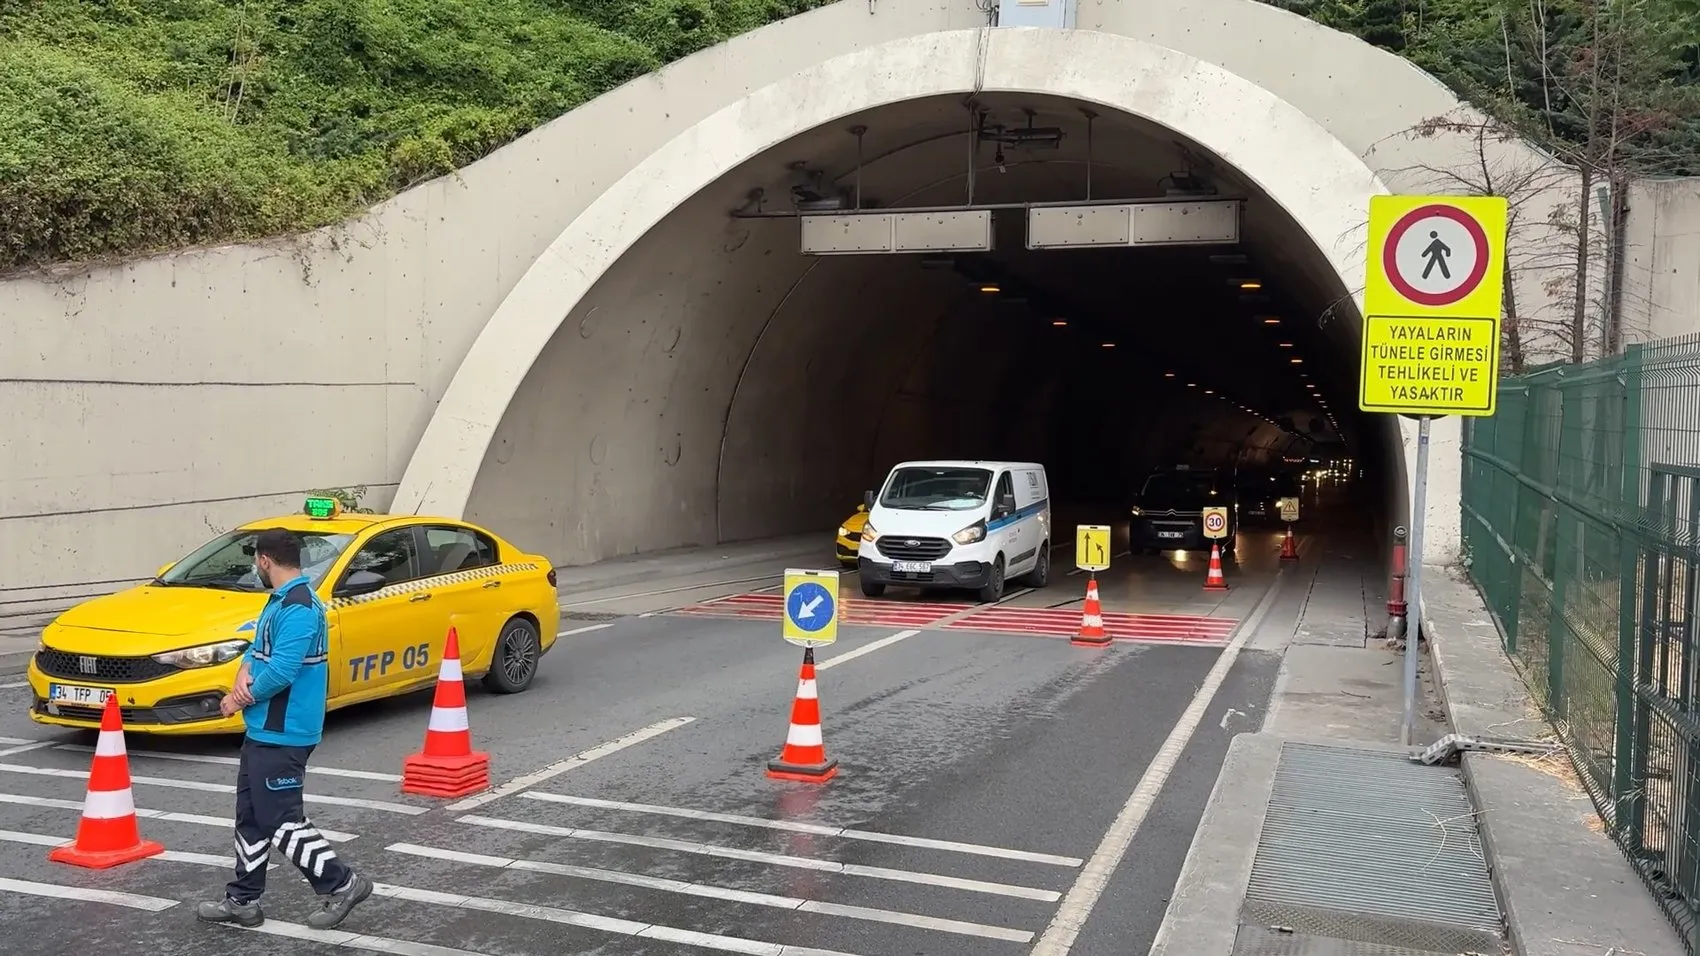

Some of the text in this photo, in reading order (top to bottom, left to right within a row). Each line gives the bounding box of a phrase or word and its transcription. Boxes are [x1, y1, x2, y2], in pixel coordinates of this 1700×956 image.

[1390, 325, 1472, 341] YAYALARIN
[1371, 342, 1488, 362] TÜNELE GİRMESİ
[1379, 363, 1478, 382] TEHLİKELİ VE
[1390, 385, 1464, 401] YASAKTIR
[1208, 517, 1222, 527] 30
[80, 656, 97, 673] FIAT
[349, 643, 429, 682] TFP 05
[57, 686, 67, 699] 34
[75, 688, 91, 701] TFP
